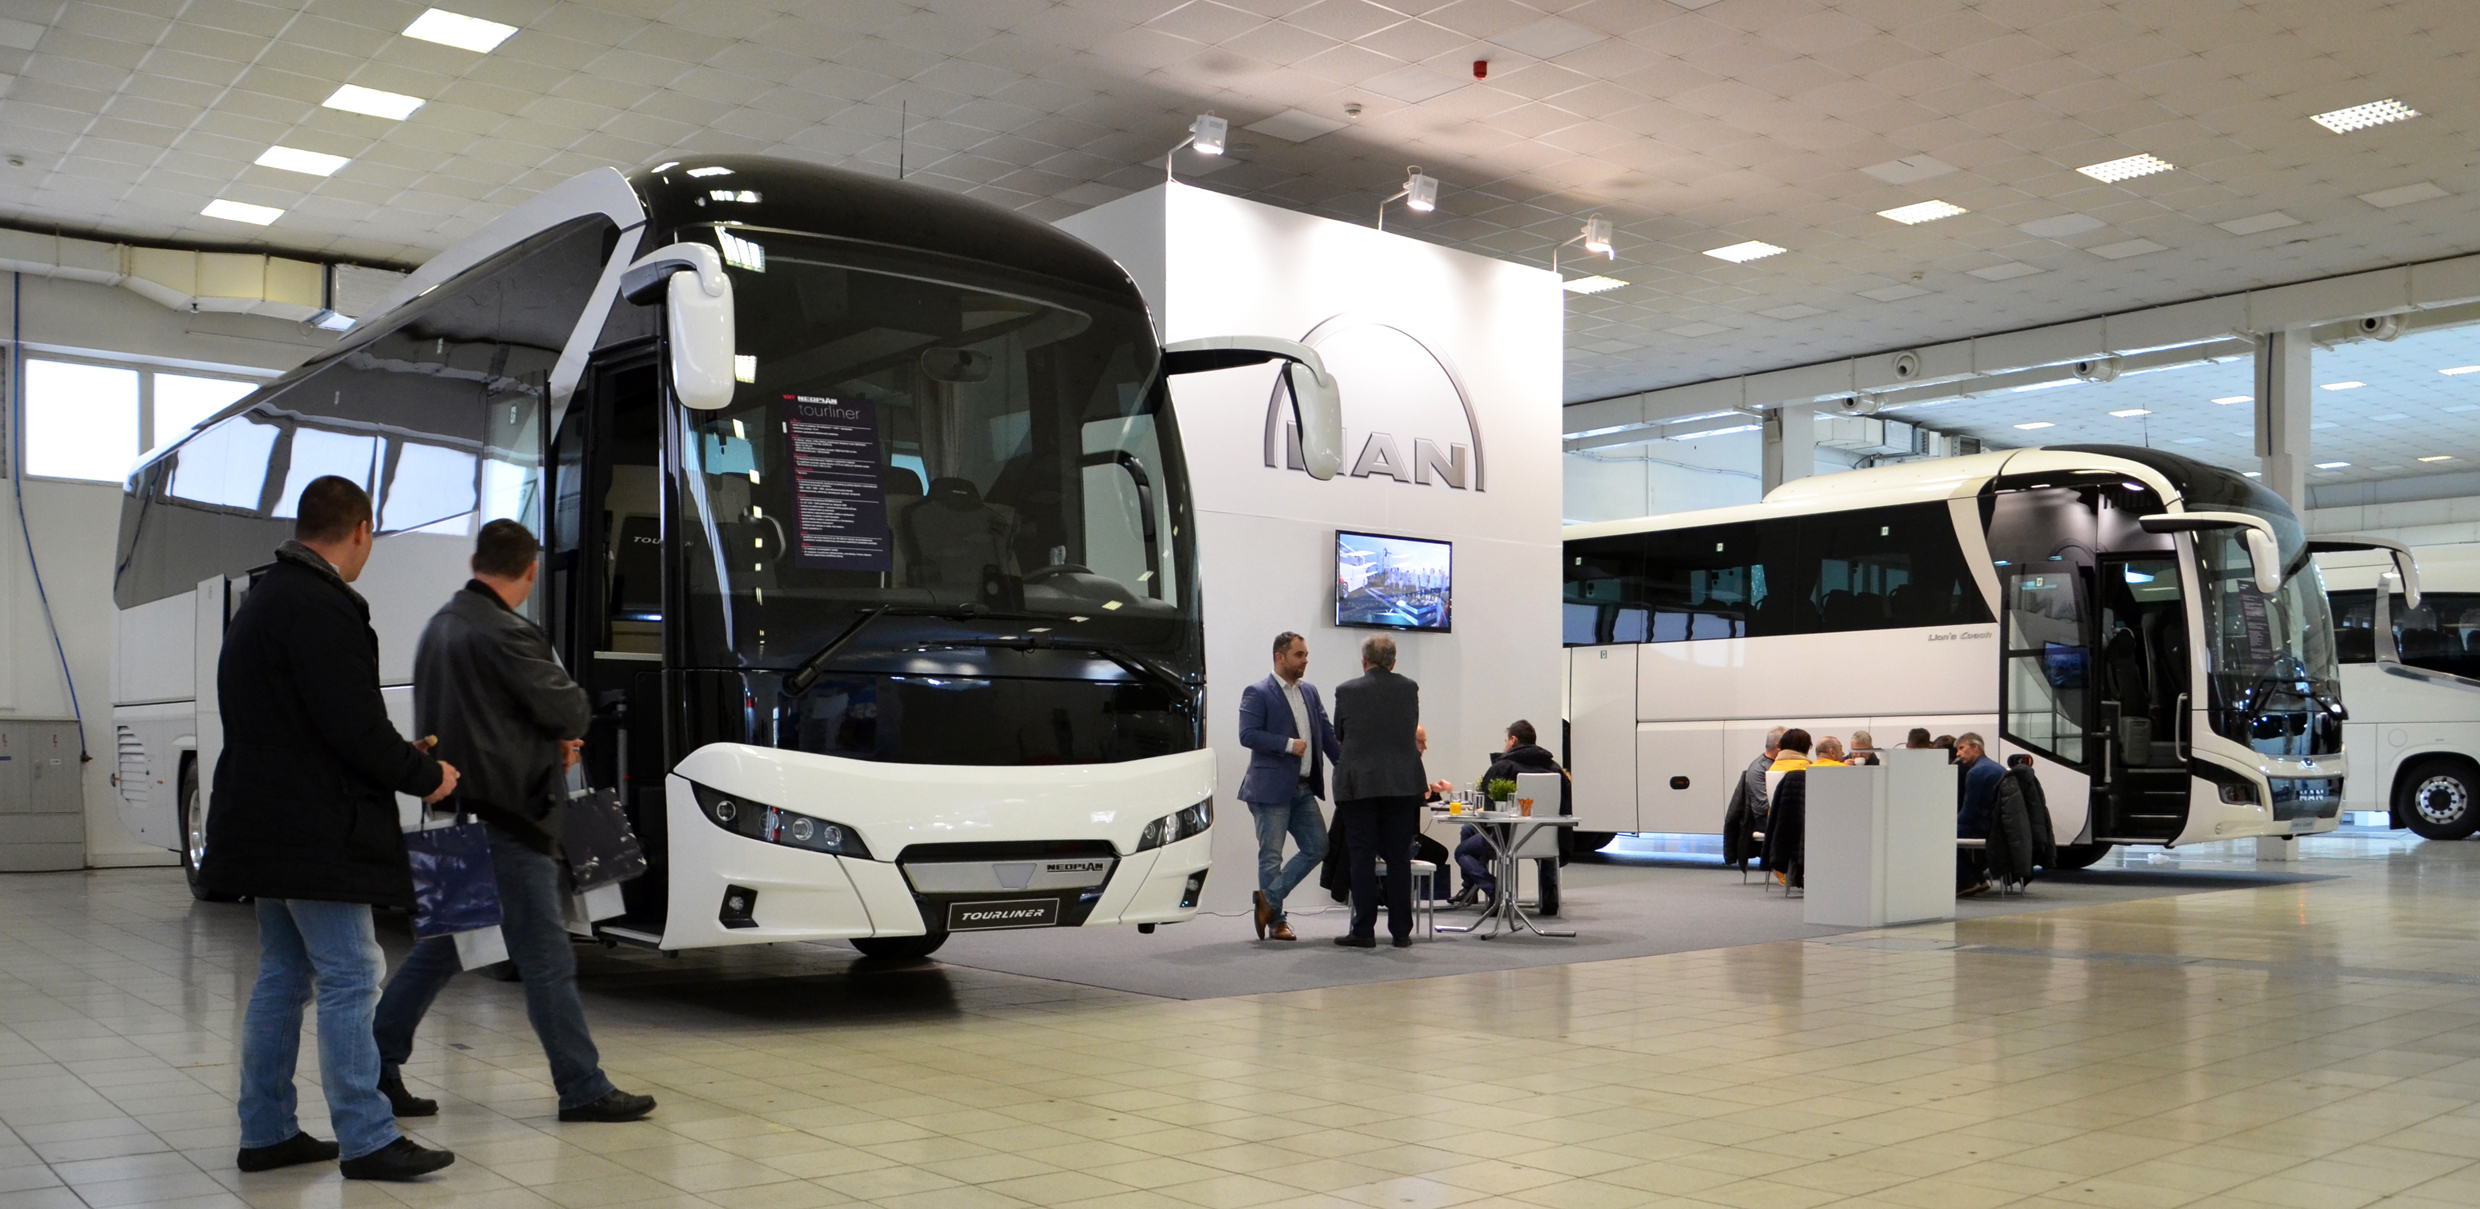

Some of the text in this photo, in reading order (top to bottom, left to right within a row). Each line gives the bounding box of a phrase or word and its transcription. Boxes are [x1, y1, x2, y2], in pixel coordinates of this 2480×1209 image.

[797, 395, 838, 405] NEOPLAN
[798, 404, 861, 420] tourliner
[1960, 631, 1993, 640] Coach
[2299, 789, 2324, 801] MAN
[1047, 862, 1104, 872] NEOPLAN
[962, 909, 1045, 921] TOURLINER
